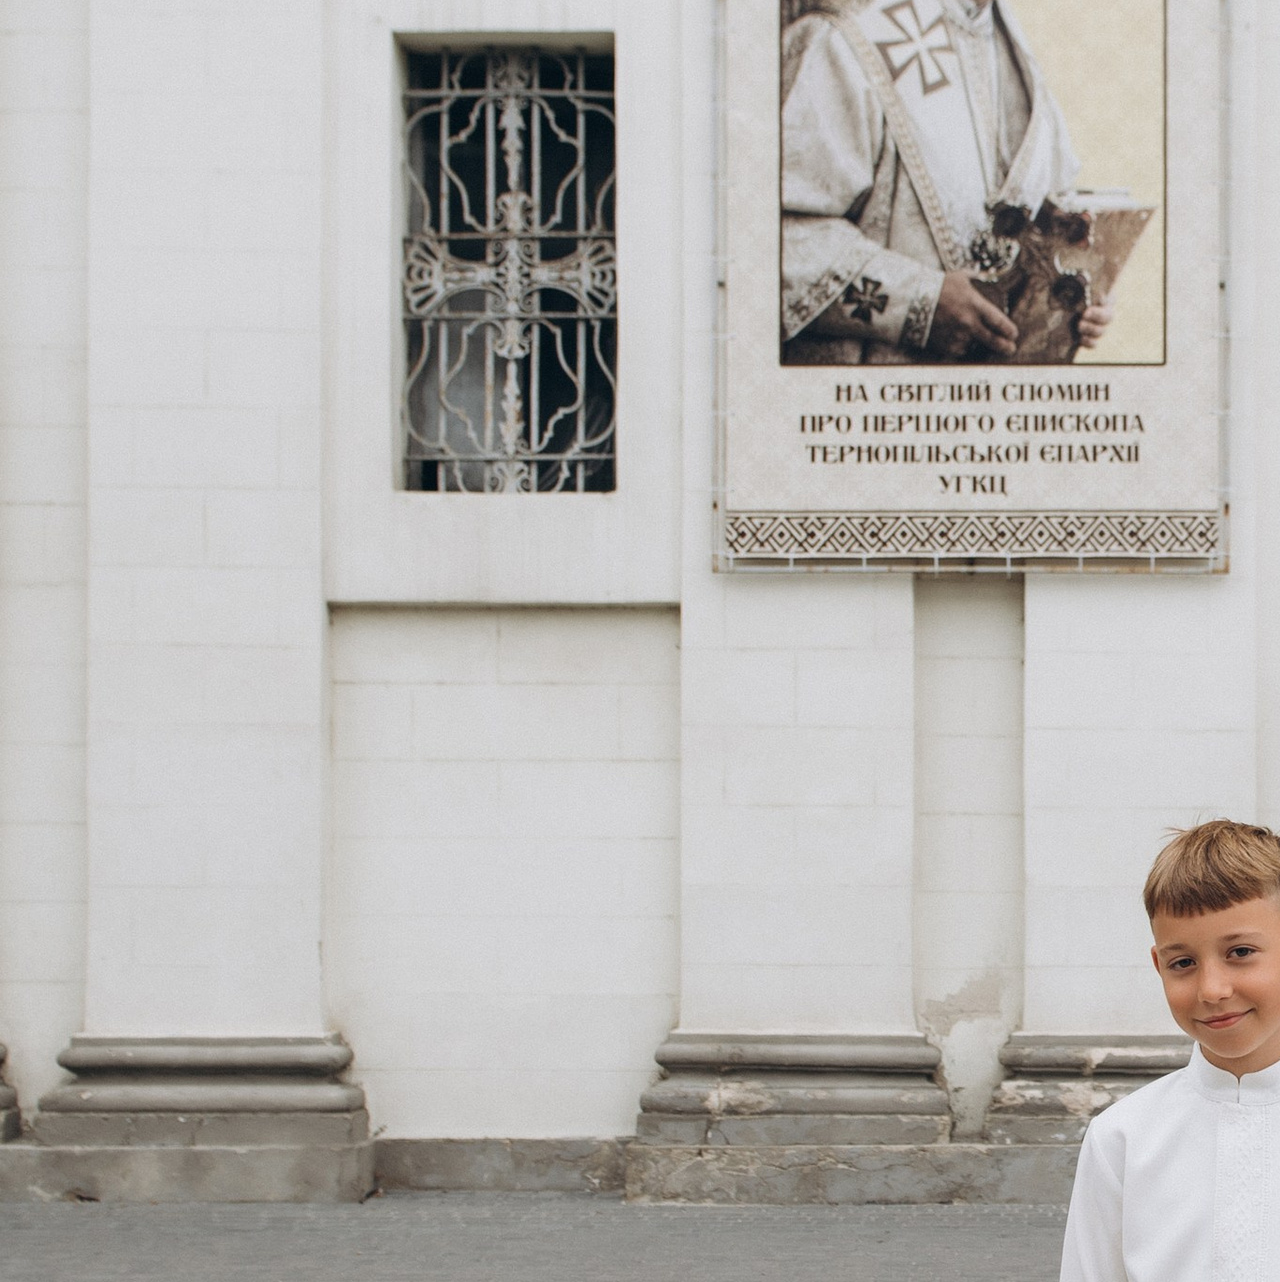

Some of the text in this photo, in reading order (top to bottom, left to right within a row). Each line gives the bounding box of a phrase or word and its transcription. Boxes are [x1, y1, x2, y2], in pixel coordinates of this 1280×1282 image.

[835, 379, 1111, 403] НА СВІТЛИЙ СПОМИН
[799, 413, 1145, 434] ПРО ПЕРШОГО ЄПИСКОПА
[805, 441, 1140, 464] ТЕРНОПІЛЬСЬКОЇ ЄПАРХІЇ
[938, 474, 1008, 497] УГКЦ
